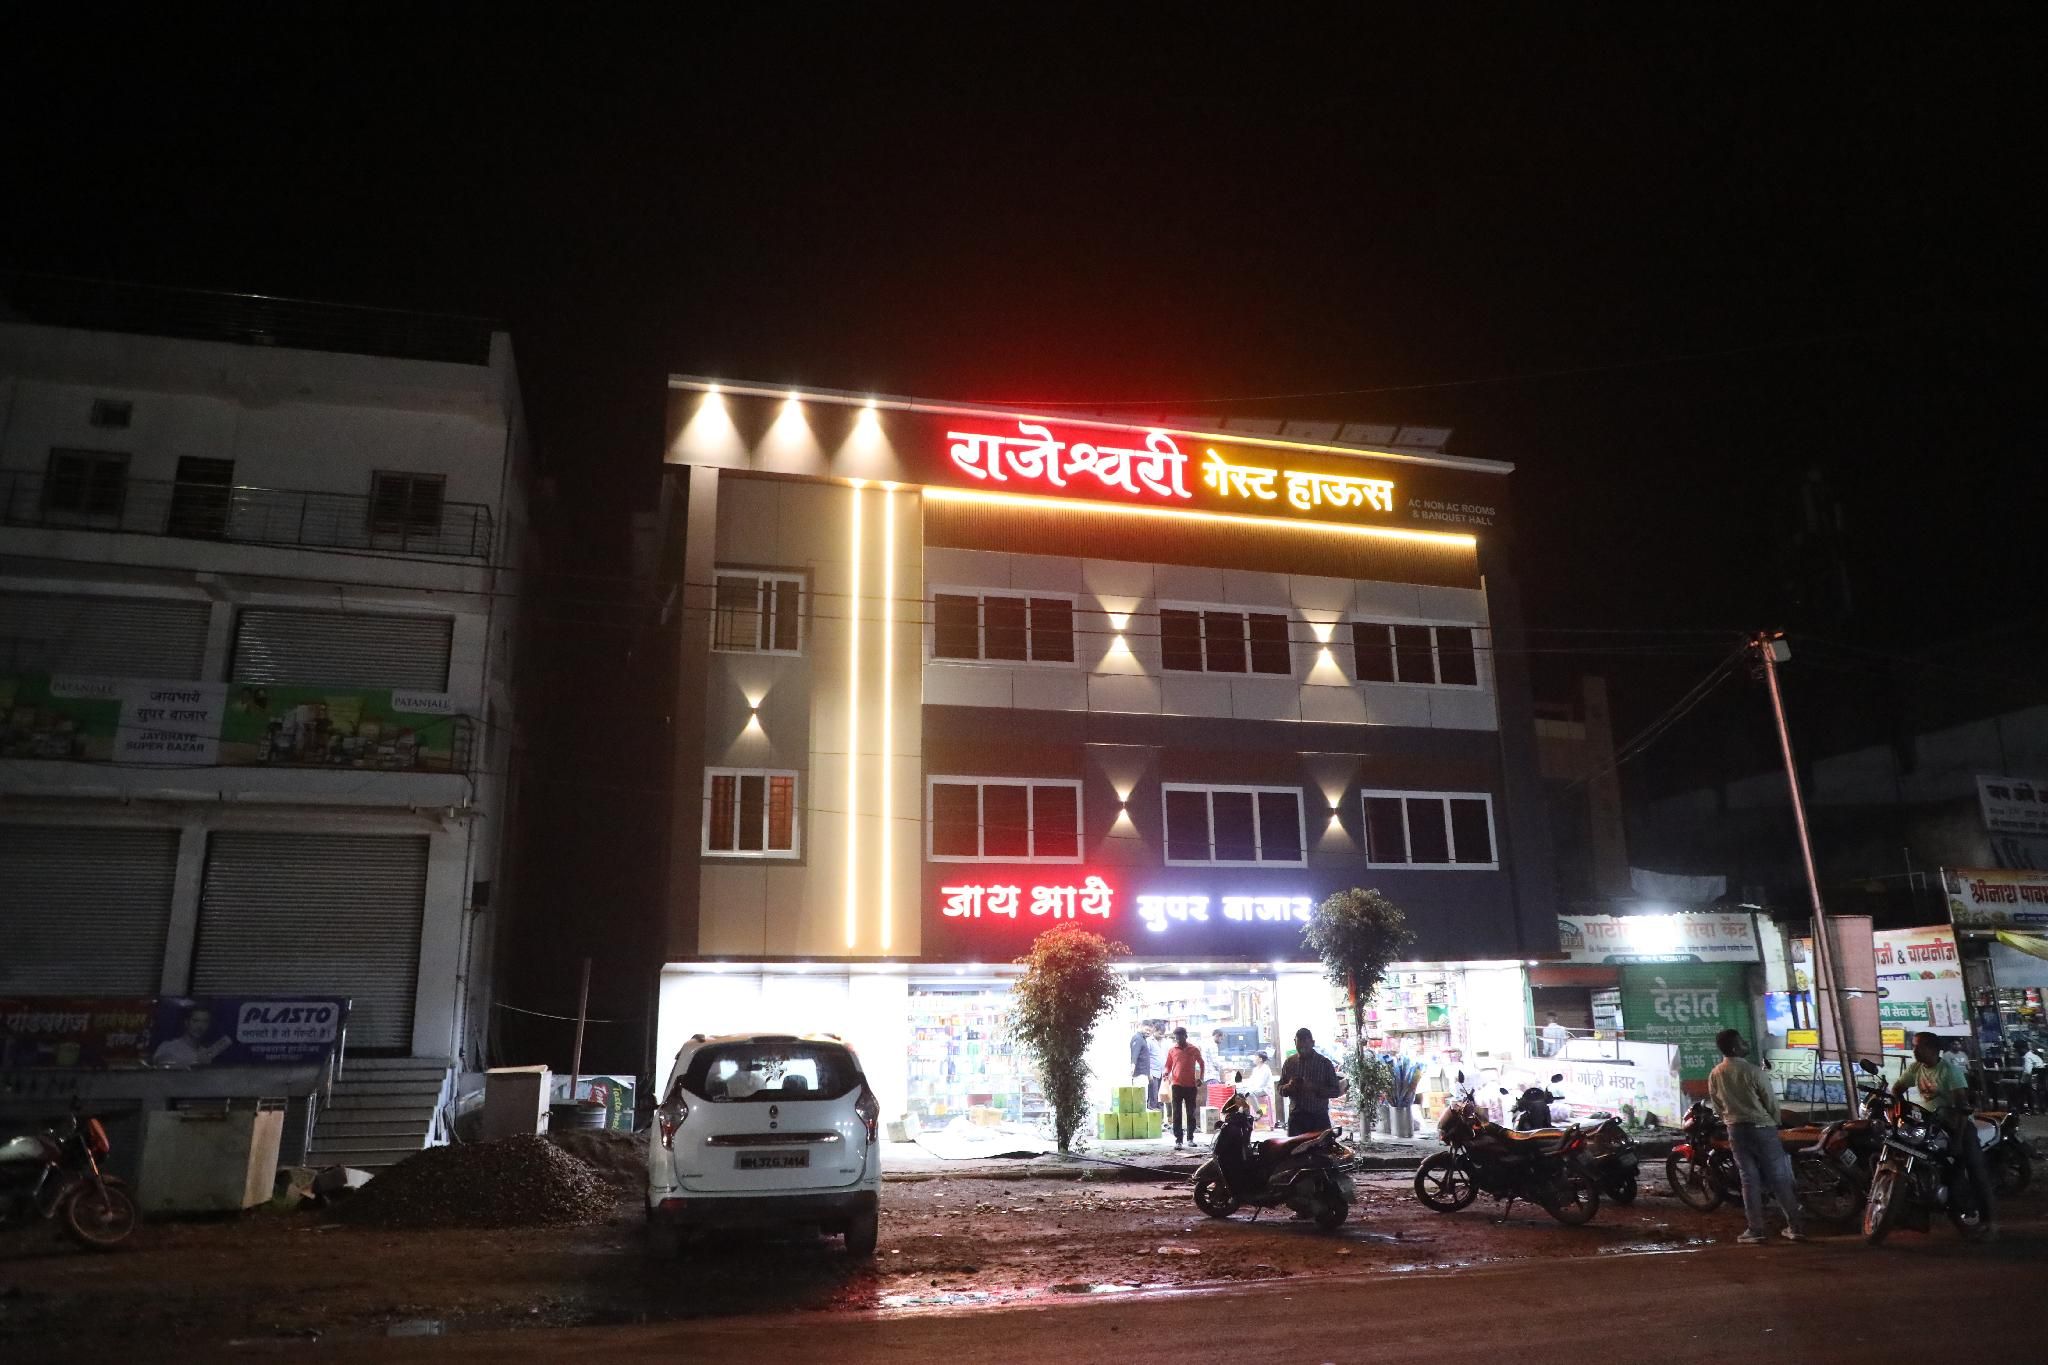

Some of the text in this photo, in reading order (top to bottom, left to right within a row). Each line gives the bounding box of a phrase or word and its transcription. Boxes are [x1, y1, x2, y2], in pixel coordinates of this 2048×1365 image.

[947, 421, 1394, 511] राजेश्वरी गेस्ट हाऊस
[1408, 498, 1496, 516] AC NON AC ROOMS
[1421, 510, 1467, 523] BANQUET
[1468, 515, 1494, 527] HALL
[126, 741, 205, 753] SUPER BAZAR
[1136, 894, 1210, 932] सुपर
[1221, 895, 1313, 923] बाजार
[1897, 949, 1907, 965] &
[1649, 976, 1720, 1022] देहात
[243, 1007, 332, 1024] PLASTO
